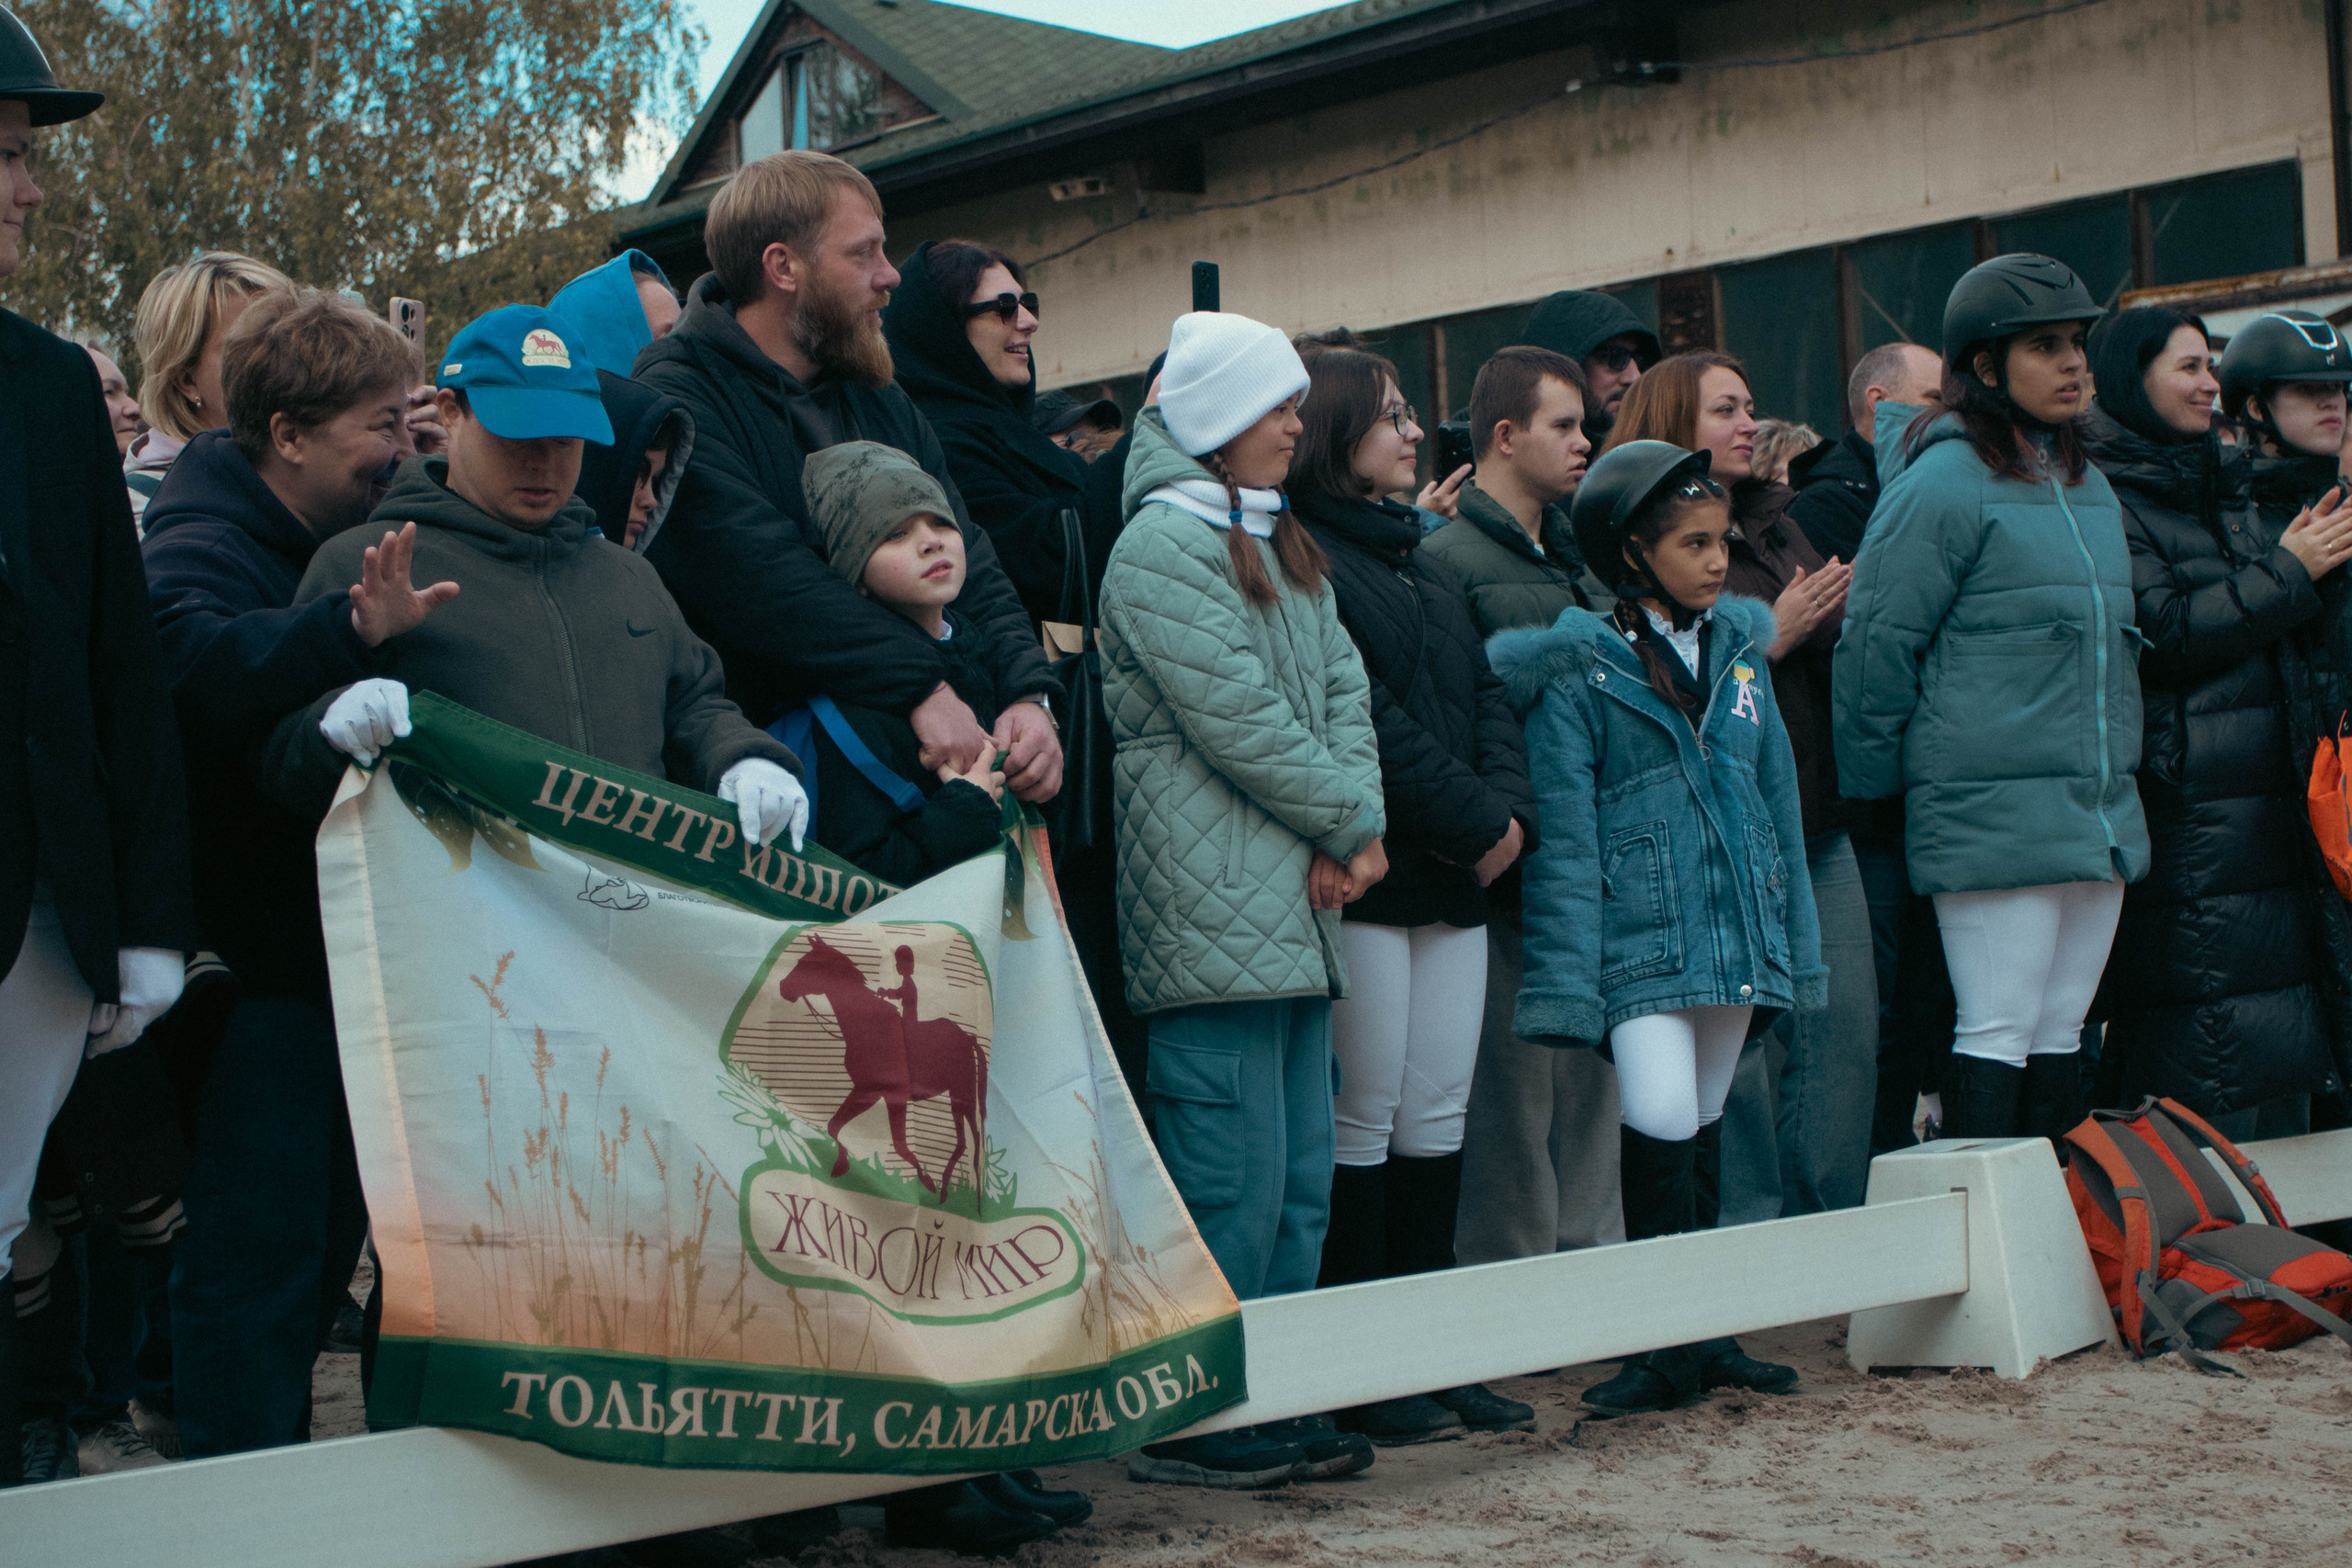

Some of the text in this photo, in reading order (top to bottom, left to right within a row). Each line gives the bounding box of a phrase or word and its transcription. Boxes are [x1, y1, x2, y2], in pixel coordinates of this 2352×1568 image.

[532, 761, 735, 863] ЦЕНТР
[765, 1190, 1065, 1301] ЖИВОЙ МИР
[501, 1354, 1218, 1457] ТОЛЬЯТТИ, САМАРСКА ОБЛ.
